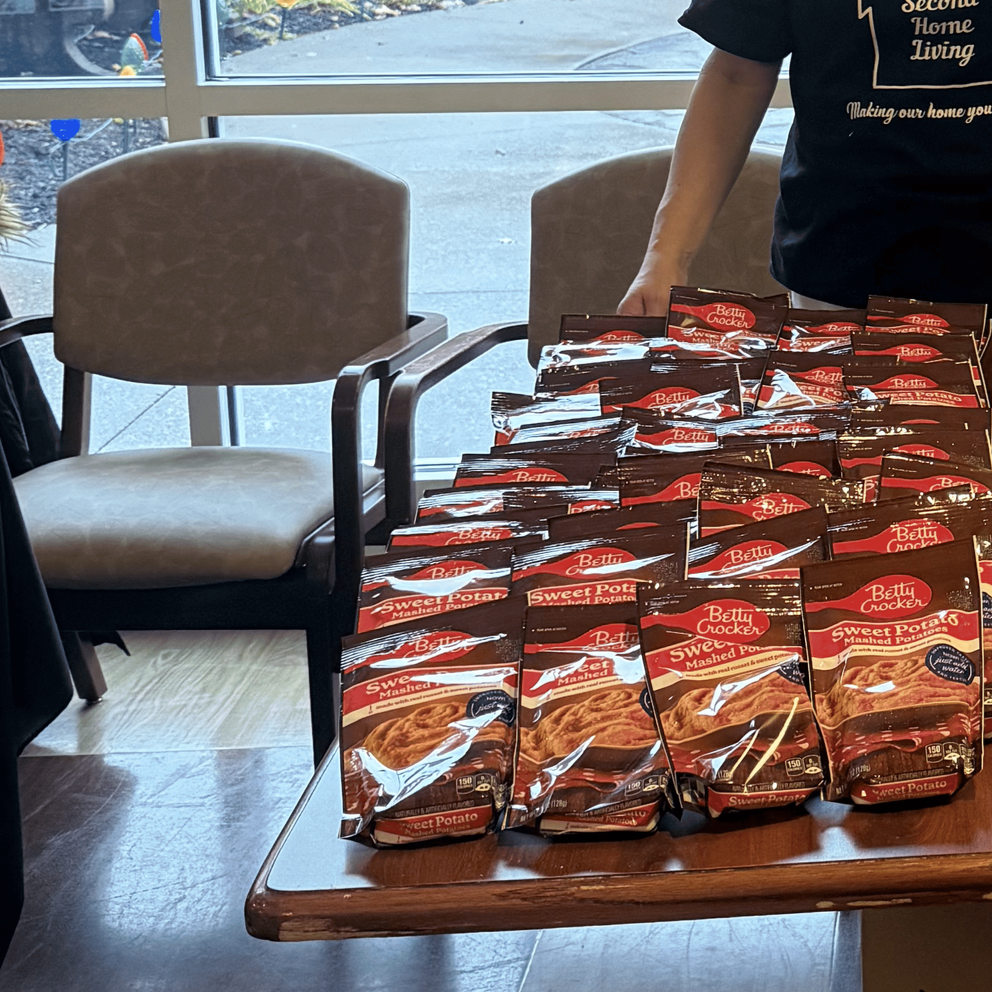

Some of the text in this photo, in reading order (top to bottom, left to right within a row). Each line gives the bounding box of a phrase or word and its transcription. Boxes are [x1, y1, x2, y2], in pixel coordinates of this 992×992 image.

[911, 17, 974, 35] Home
[910, 40, 975, 66] Living
[847, 102, 899, 124] Making
[899, 109, 925, 118] our
[927, 102, 966, 119] home
[713, 305, 746, 318] Betty
[707, 312, 753, 329] Crocker
[891, 379, 926, 388] Betty
[651, 391, 690, 405] Betty
[916, 392, 962, 402] Potato
[669, 428, 709, 441] Betty
[457, 530, 503, 540] Betty
[890, 526, 938, 543] Betty
[574, 554, 624, 568] Betty
[725, 545, 773, 564] Betty
[531, 585, 592, 604] Sweet
[865, 582, 915, 602] Betty
[381, 596, 442, 614] Sweet
[392, 606, 441, 619] Mashed
[860, 597, 928, 613] Crocker
[703, 605, 754, 626] Betty
[697, 619, 765, 635] Crocker
[832, 613, 959, 642] Sweet Potato
[844, 626, 948, 646] Mashed Potatoes
[686, 650, 736, 670] Mashed
[933, 656, 968, 671] just add
[558, 670, 608, 686] Mashed
[942, 666, 964, 674] water
[366, 675, 411, 695] Swe
[379, 682, 431, 700] Mashed
[927, 746, 941, 754] 150
[788, 760, 800, 768] 150
[458, 777, 472, 785] 150
[908, 780, 947, 792] Potato
[728, 796, 766, 806] Sweet
[406, 813, 478, 830] weet Potato
